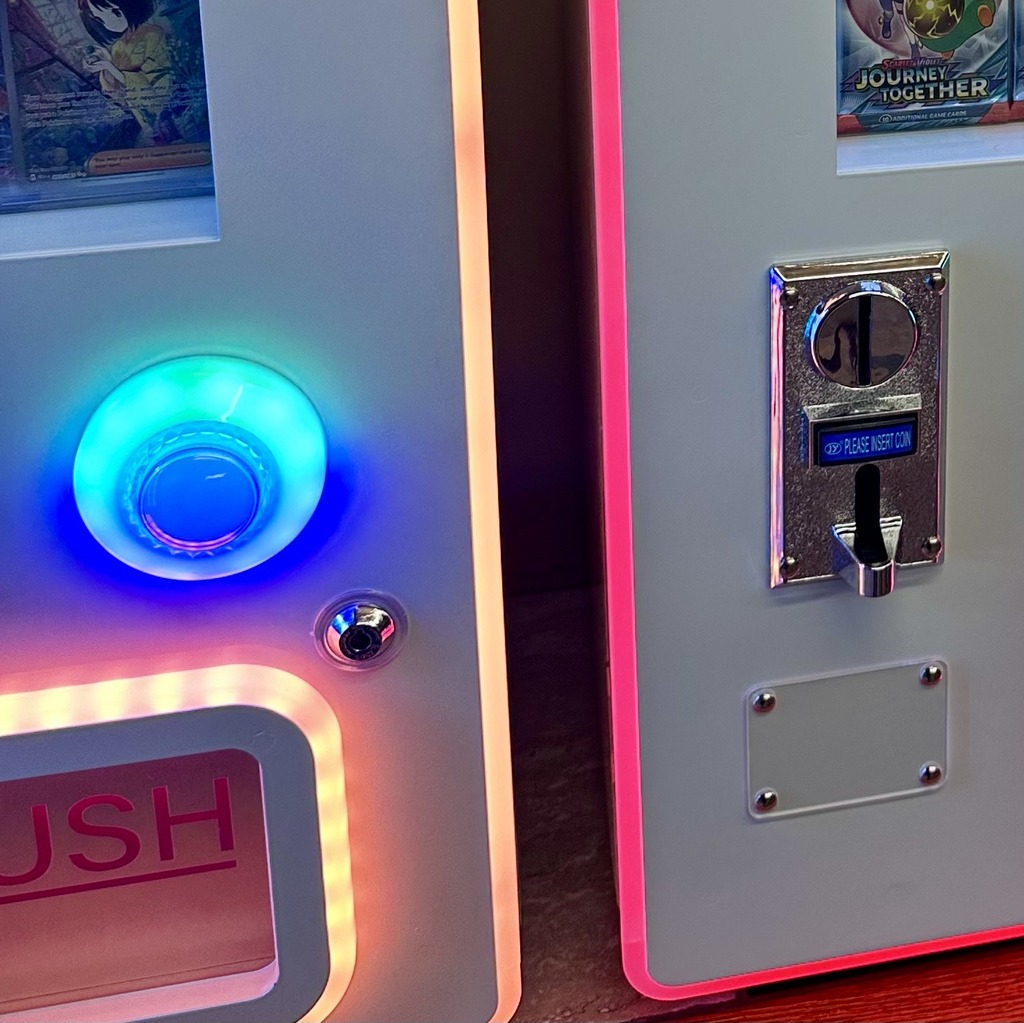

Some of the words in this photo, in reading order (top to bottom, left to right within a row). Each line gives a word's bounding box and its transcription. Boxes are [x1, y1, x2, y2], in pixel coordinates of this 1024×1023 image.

[854, 65, 947, 91] JOURNEY
[881, 77, 989, 102] TOGETHER
[893, 113, 928, 121] ADDITIONAL
[947, 110, 967, 118] CARDS
[844, 436, 870, 455] PLEASE
[870, 433, 894, 452] INSERT
[895, 430, 911, 448] COIN
